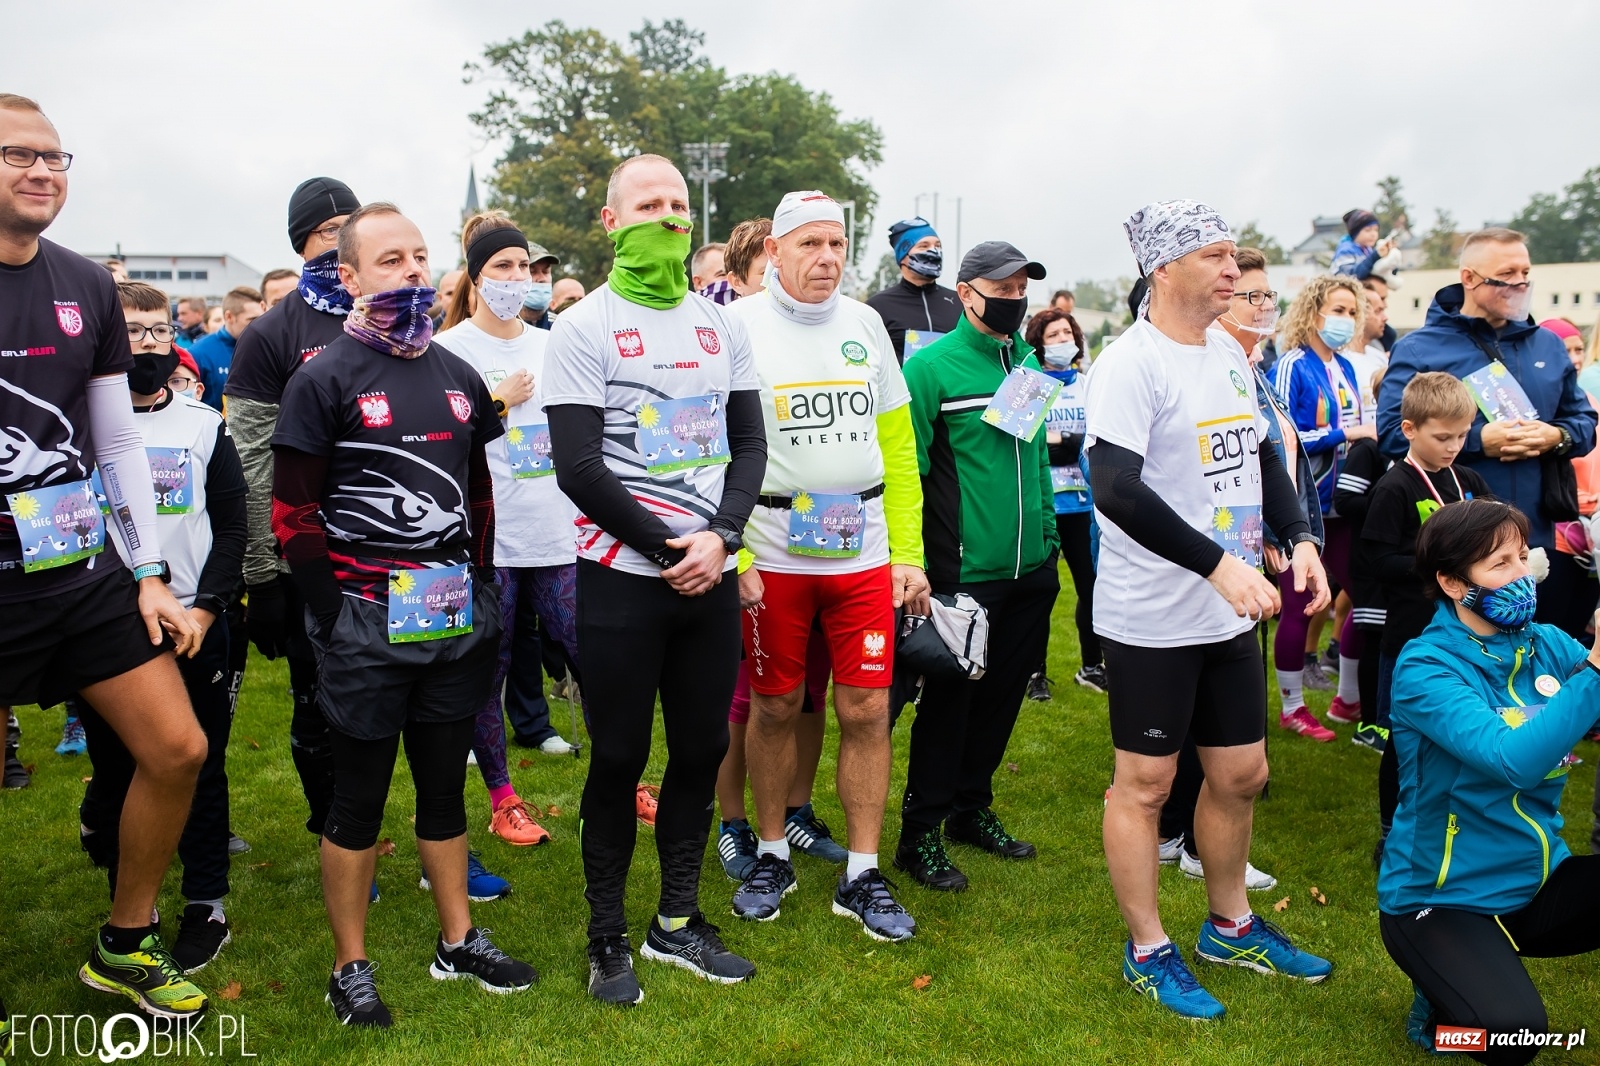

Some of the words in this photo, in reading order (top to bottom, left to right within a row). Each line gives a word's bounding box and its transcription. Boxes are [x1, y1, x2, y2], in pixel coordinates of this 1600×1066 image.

[1036, 382, 1055, 403] 322
[789, 382, 874, 429] agrol
[651, 427, 670, 437] BIEG
[673, 424, 688, 433] DLA
[697, 439, 722, 457] 236
[152, 470, 186, 479] BOŻENY
[154, 490, 184, 507] 286
[31, 517, 51, 528] BIEG
[55, 514, 70, 523] DLA
[802, 514, 819, 523] BIEG
[823, 516, 837, 524] DLA
[77, 532, 99, 549] 025
[124, 521, 140, 550] SATURN
[837, 537, 859, 548] 255
[1224, 531, 1239, 540] BIEG
[402, 595, 421, 605] BIEG
[426, 594, 441, 603] DLA
[445, 612, 467, 628] 218
[860, 663, 885, 671] ANDRZEJ
